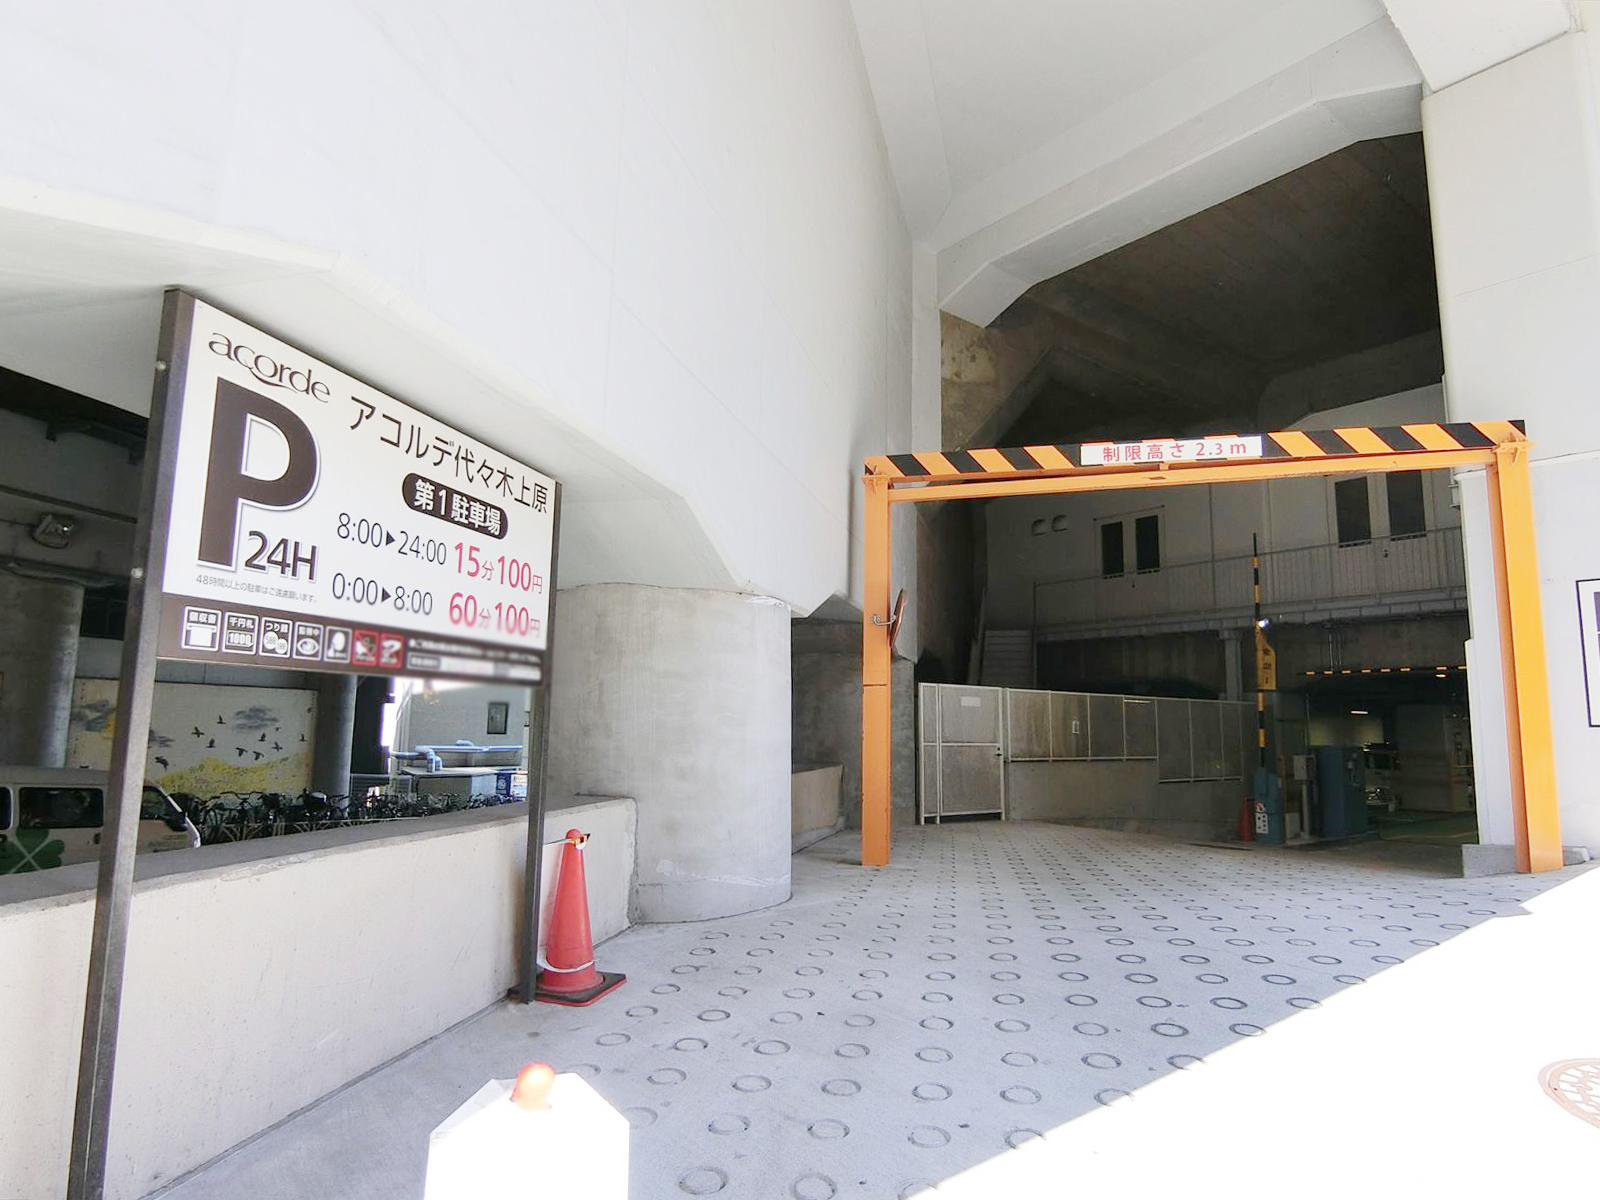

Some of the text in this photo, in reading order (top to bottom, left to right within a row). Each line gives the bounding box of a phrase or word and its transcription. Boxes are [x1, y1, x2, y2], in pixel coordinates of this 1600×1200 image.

[208, 332, 331, 404] acorde
[197, 376, 318, 567] P
[350, 395, 549, 515] アコルデ代々木上原
[1102, 443, 1185, 463] 制限高さ
[413, 479, 502, 536] 第1駐車場
[244, 530, 318, 581] 24H
[228, 631, 253, 645] 1000
[229, 616, 255, 629] 千円札
